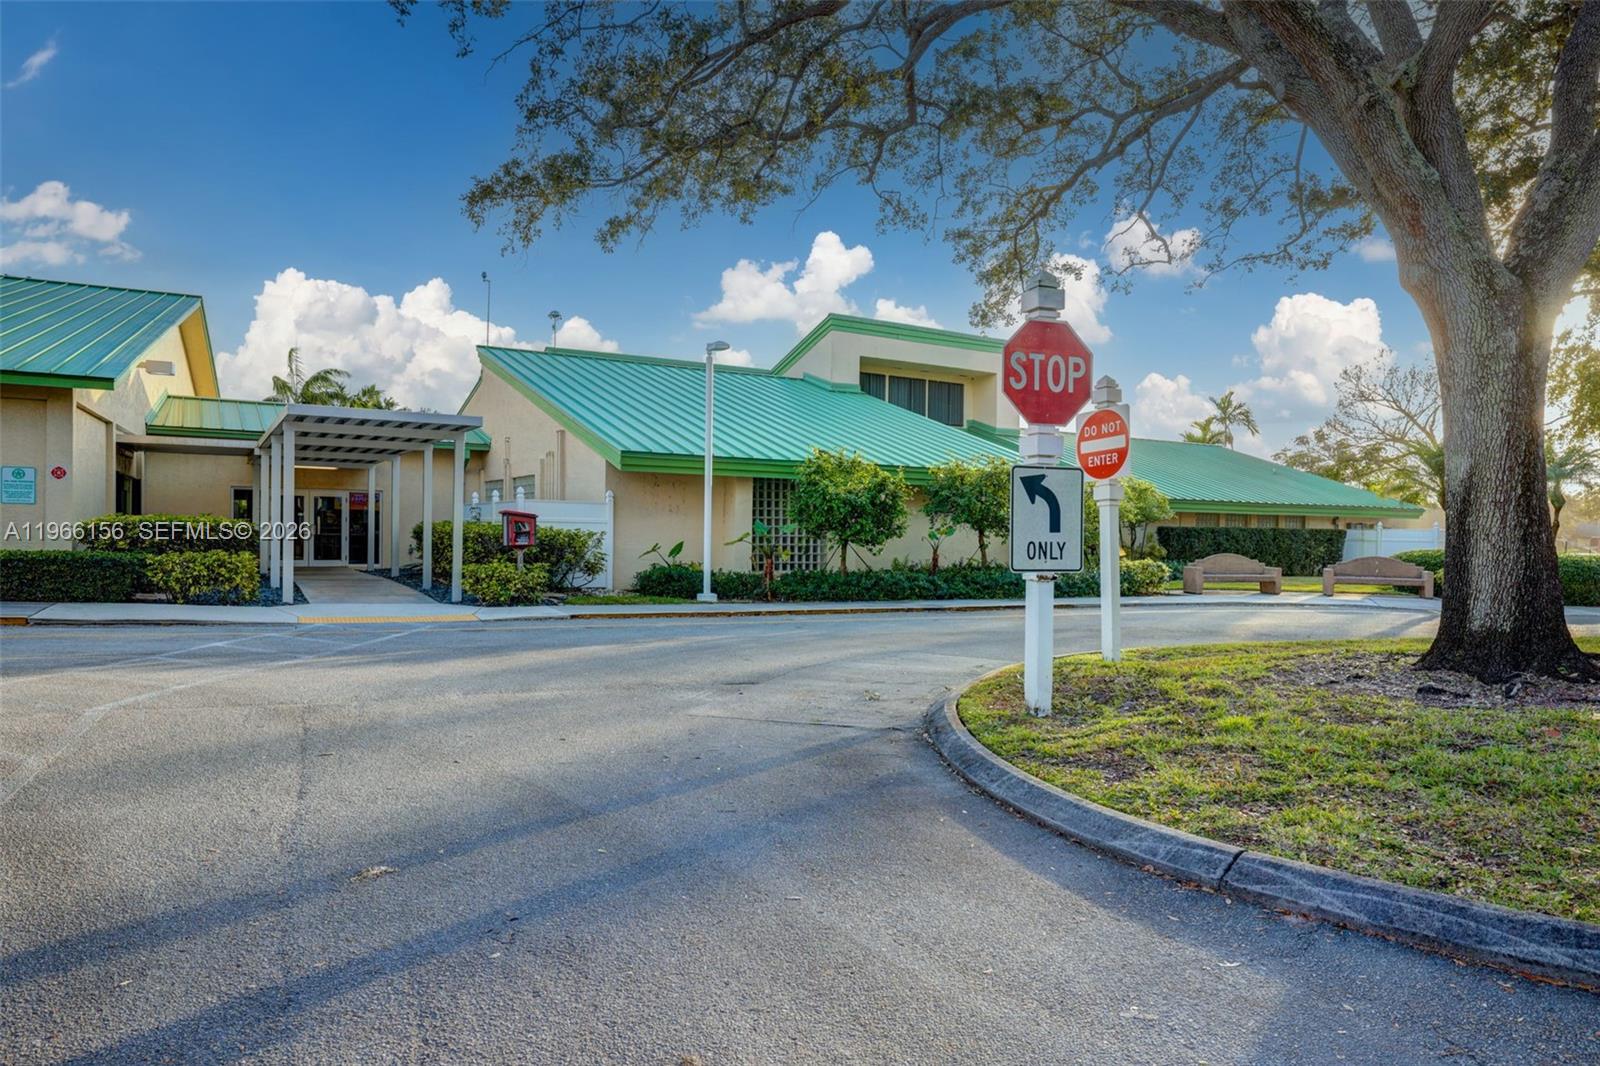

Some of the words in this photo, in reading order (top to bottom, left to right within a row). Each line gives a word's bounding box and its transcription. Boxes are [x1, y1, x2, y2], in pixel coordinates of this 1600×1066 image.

[1009, 352, 1086, 393] STOP
[1084, 425, 1097, 437] DO
[1101, 421, 1121, 433] NOT
[1088, 453, 1118, 467] ENTER
[1027, 541, 1066, 560] ONLY
